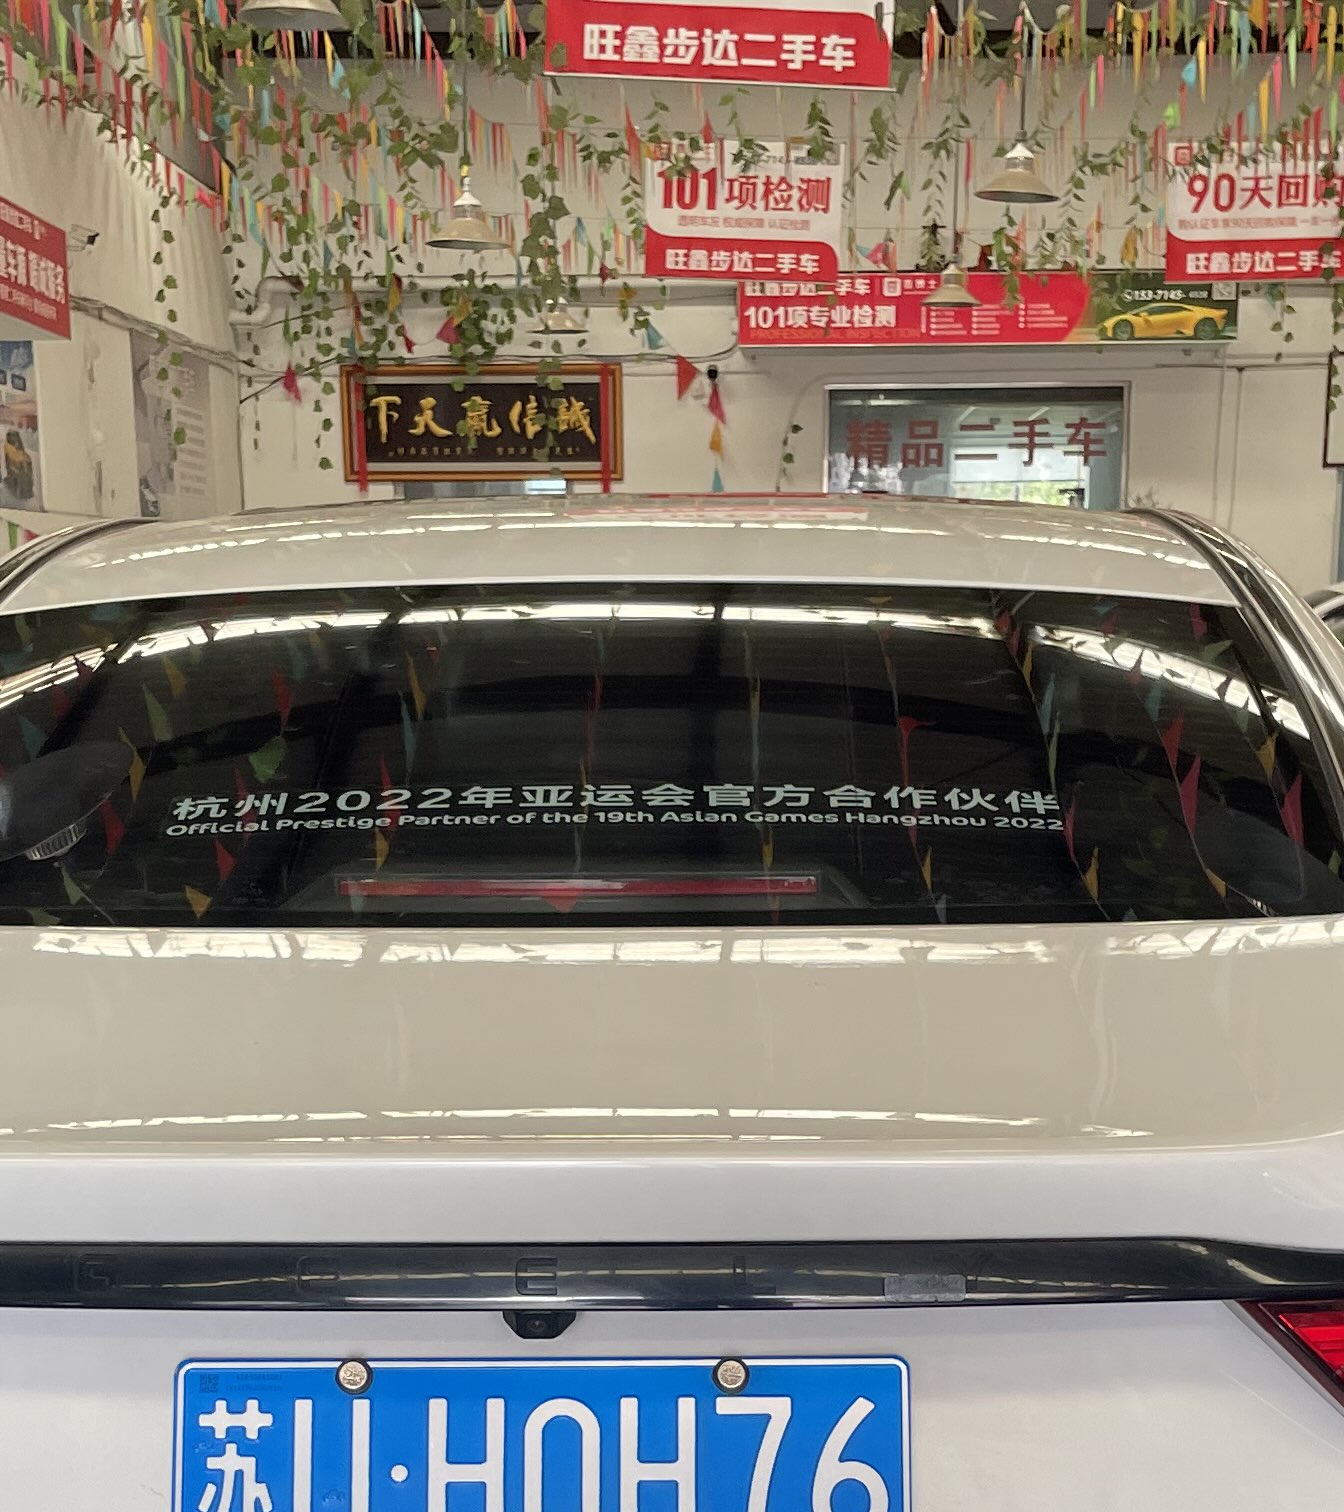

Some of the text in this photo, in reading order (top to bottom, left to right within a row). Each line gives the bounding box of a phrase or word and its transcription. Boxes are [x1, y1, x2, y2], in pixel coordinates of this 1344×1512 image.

[583, 22, 857, 73] 旺鑫步达二手车
[658, 167, 833, 214] 101项检测
[665, 248, 821, 275] 旺鑫步达二手车
[1186, 250, 1343, 275] 旺鑫步达二手车
[744, 305, 897, 328] 101项专业检测
[845, 416, 1107, 468] 精品二手车
[172, 783, 1062, 822] 杭州2022年亚运会官方合作伙伴
[165, 810, 1065, 837] Official Prestige Partner of the 19th Asian Games Hangzhou 2022
